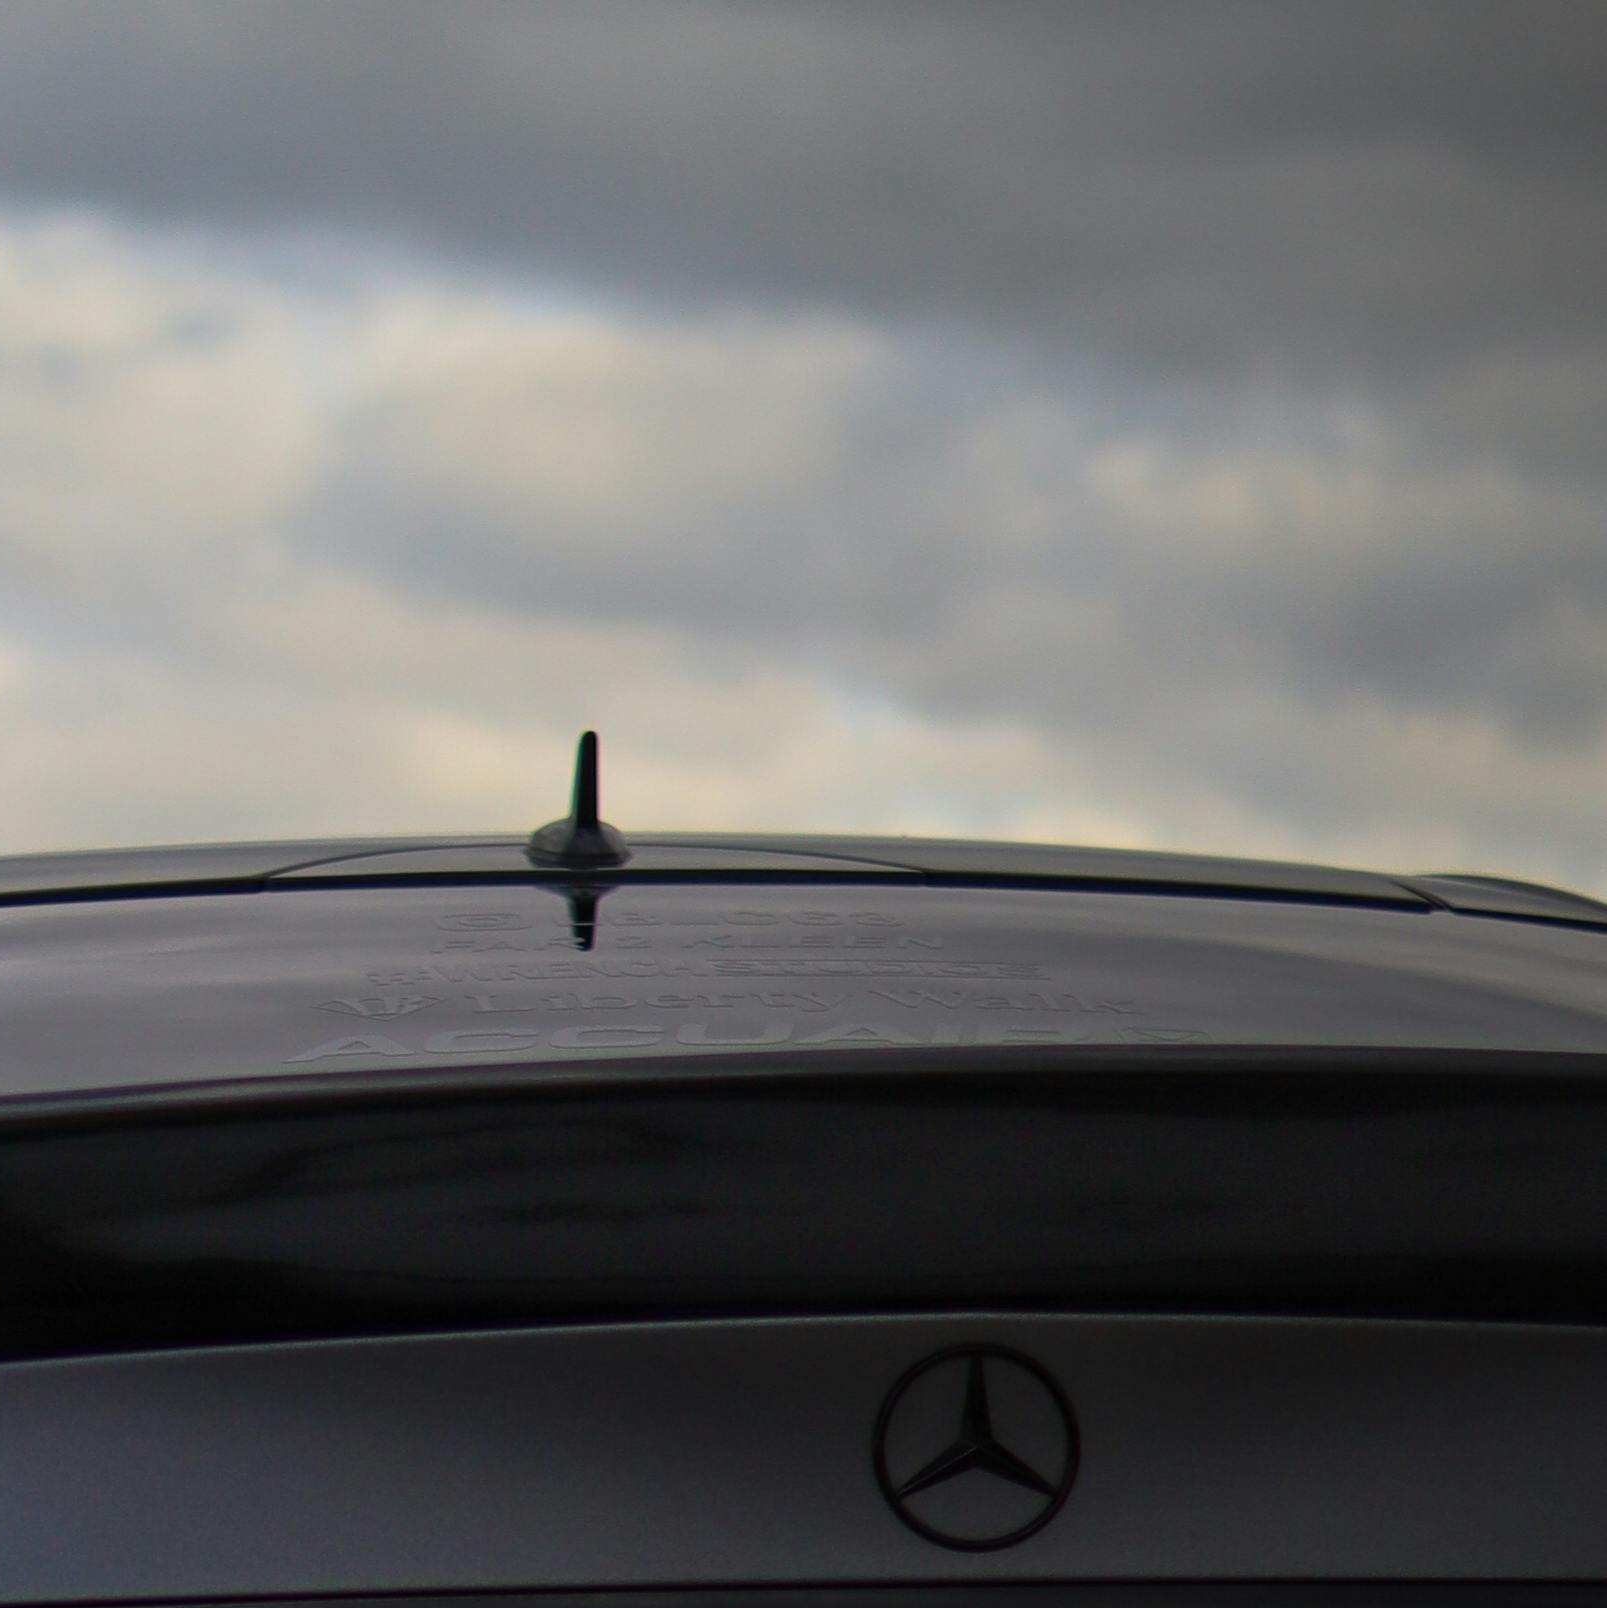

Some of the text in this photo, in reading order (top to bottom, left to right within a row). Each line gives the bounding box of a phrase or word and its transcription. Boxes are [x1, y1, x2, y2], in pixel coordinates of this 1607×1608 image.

[681, 934, 942, 950] KLEEN
[464, 990, 1144, 1015] Liberty Walk
